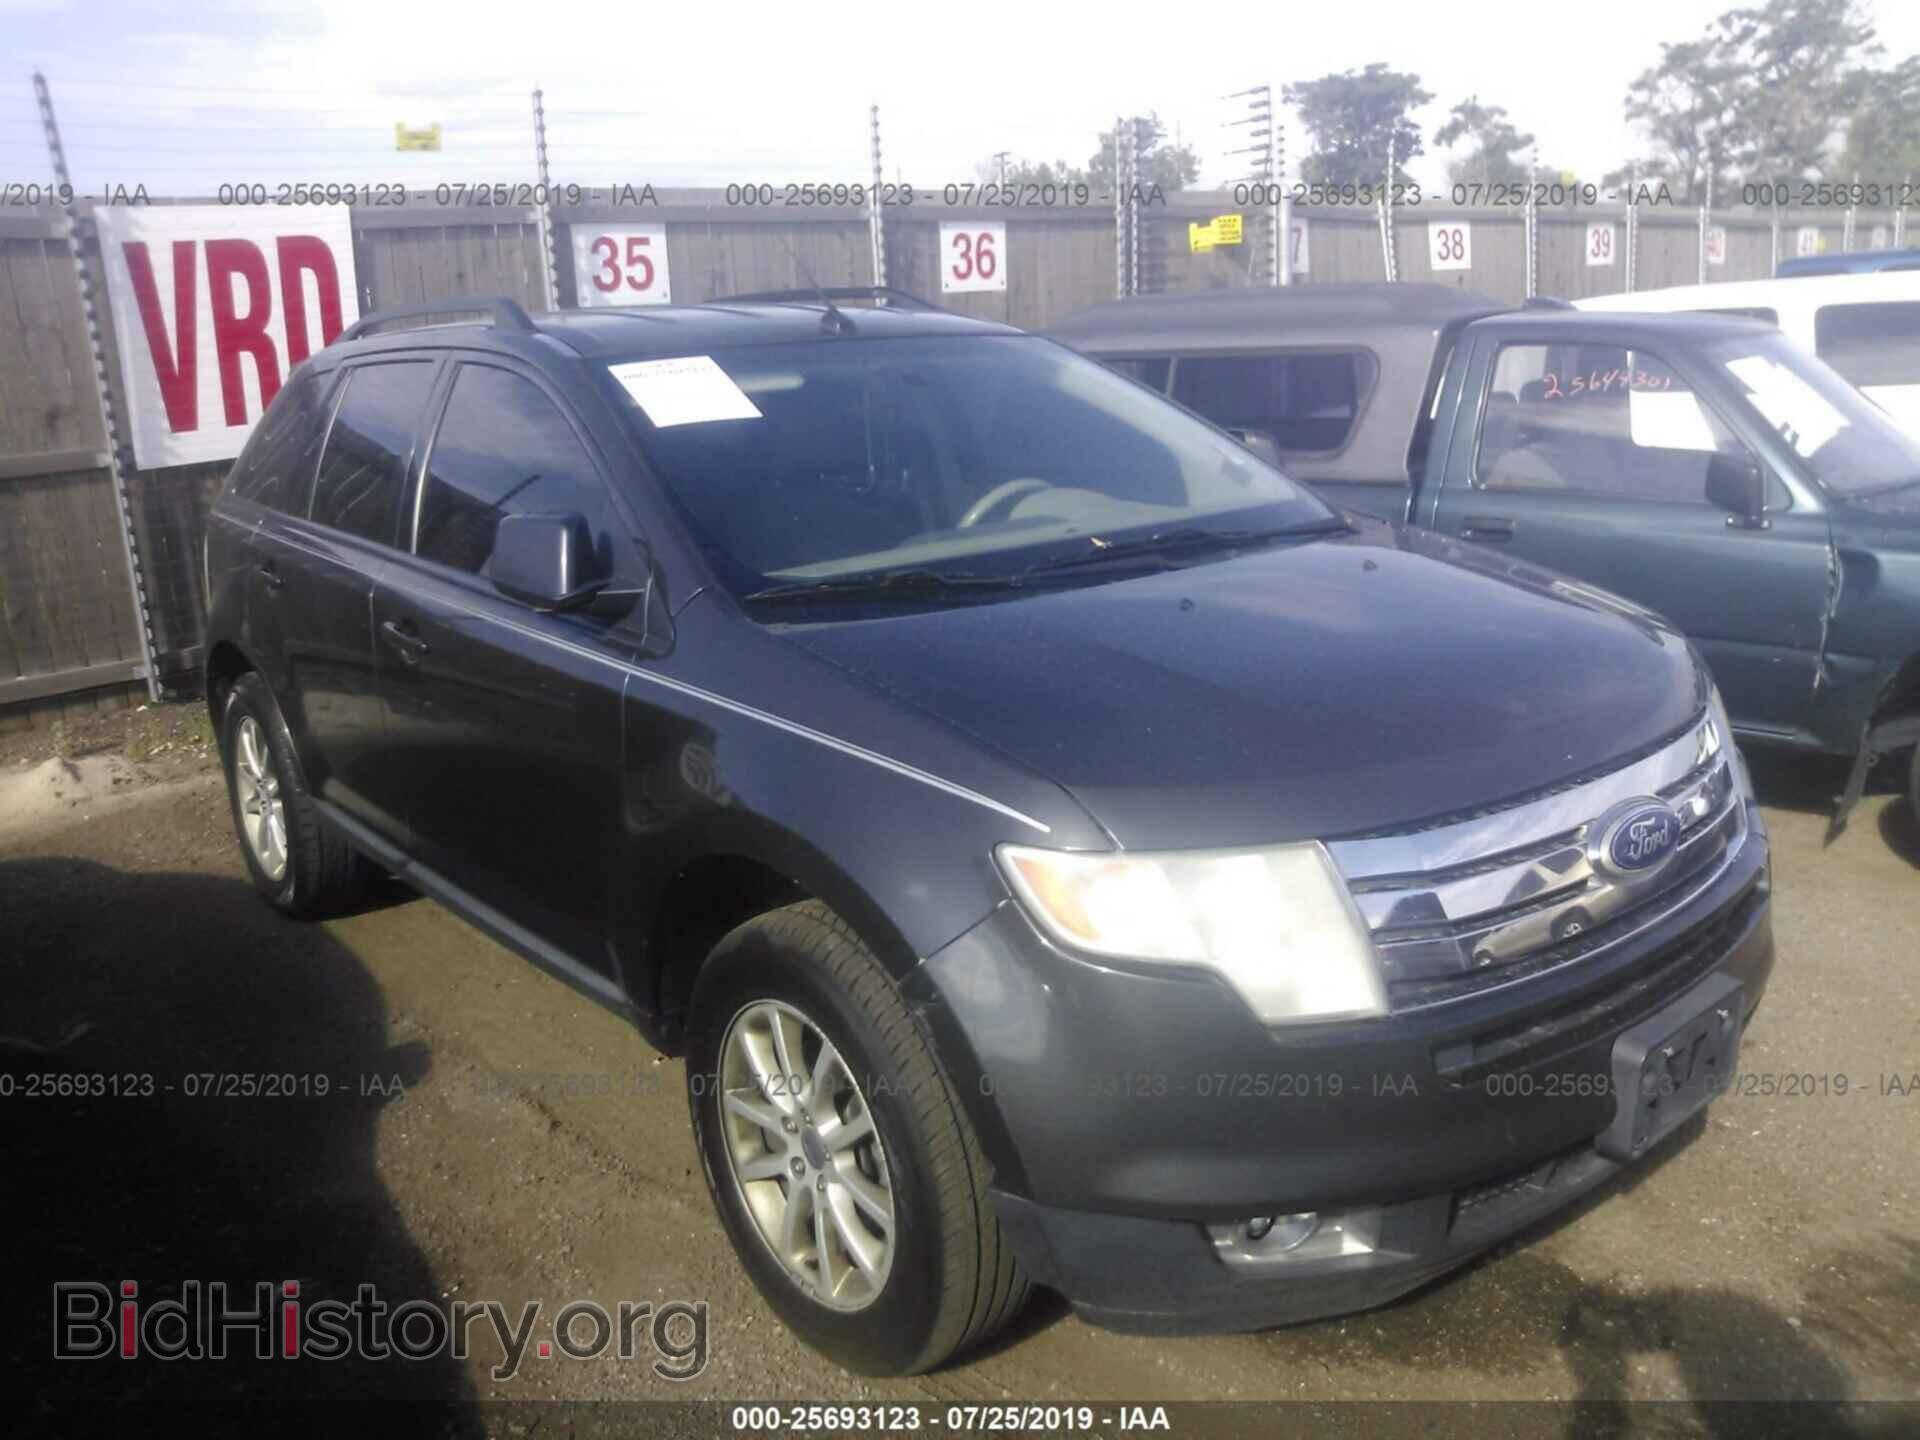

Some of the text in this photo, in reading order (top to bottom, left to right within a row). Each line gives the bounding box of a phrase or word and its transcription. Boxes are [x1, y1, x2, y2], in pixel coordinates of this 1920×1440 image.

[591, 236, 655, 292] 35
[952, 232, 996, 280] 36
[1437, 229, 1465, 261] 38
[1591, 228, 1611, 258] 39
[1624, 816, 1670, 861] Ford
